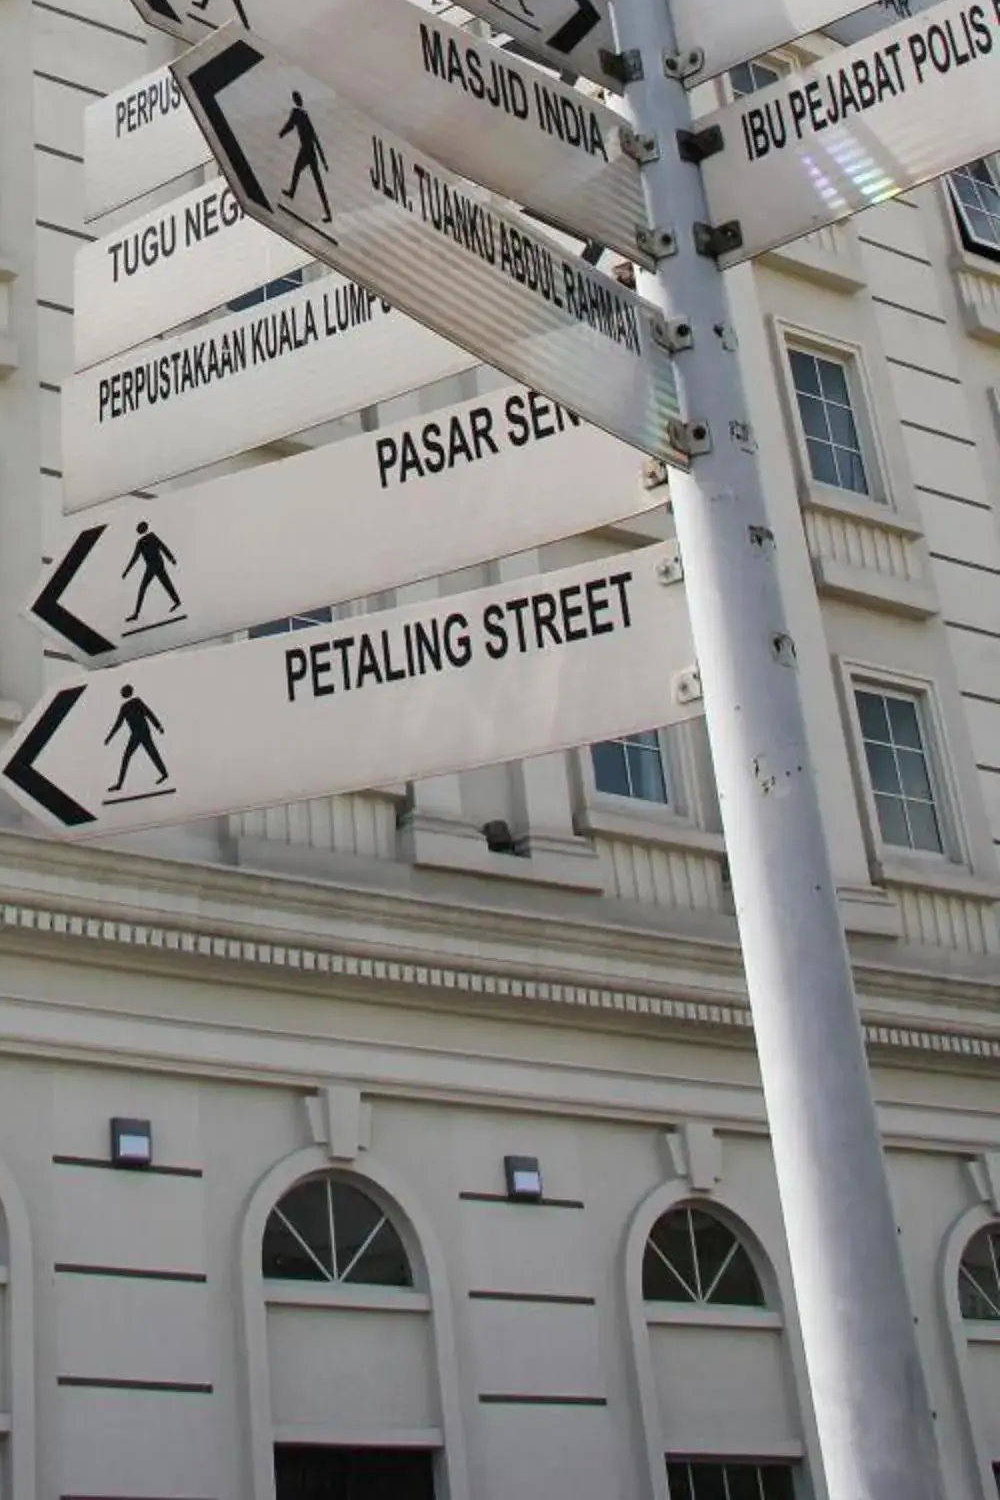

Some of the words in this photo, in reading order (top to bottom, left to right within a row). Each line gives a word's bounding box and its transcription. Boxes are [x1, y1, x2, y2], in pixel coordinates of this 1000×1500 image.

[420, 23, 529, 119] MASJID
[534, 81, 609, 163] INDIA
[741, 100, 787, 161] IBU
[788, 43, 905, 140] PEJABAT
[908, 5, 992, 83] POLIS
[108, 215, 176, 283] TUGU
[370, 135, 413, 212] JLN.
[414, 164, 496, 266] TUANKU
[500, 222, 564, 308] ABDUL
[562, 260, 640, 356] RAHMAN
[99, 327, 246, 423] PERPUSTAKAAN
[251, 300, 318, 365] KUALA
[376, 407, 499, 488] PASAR
[285, 613, 473, 702] PETALING
[482, 571, 632, 659] STREET
